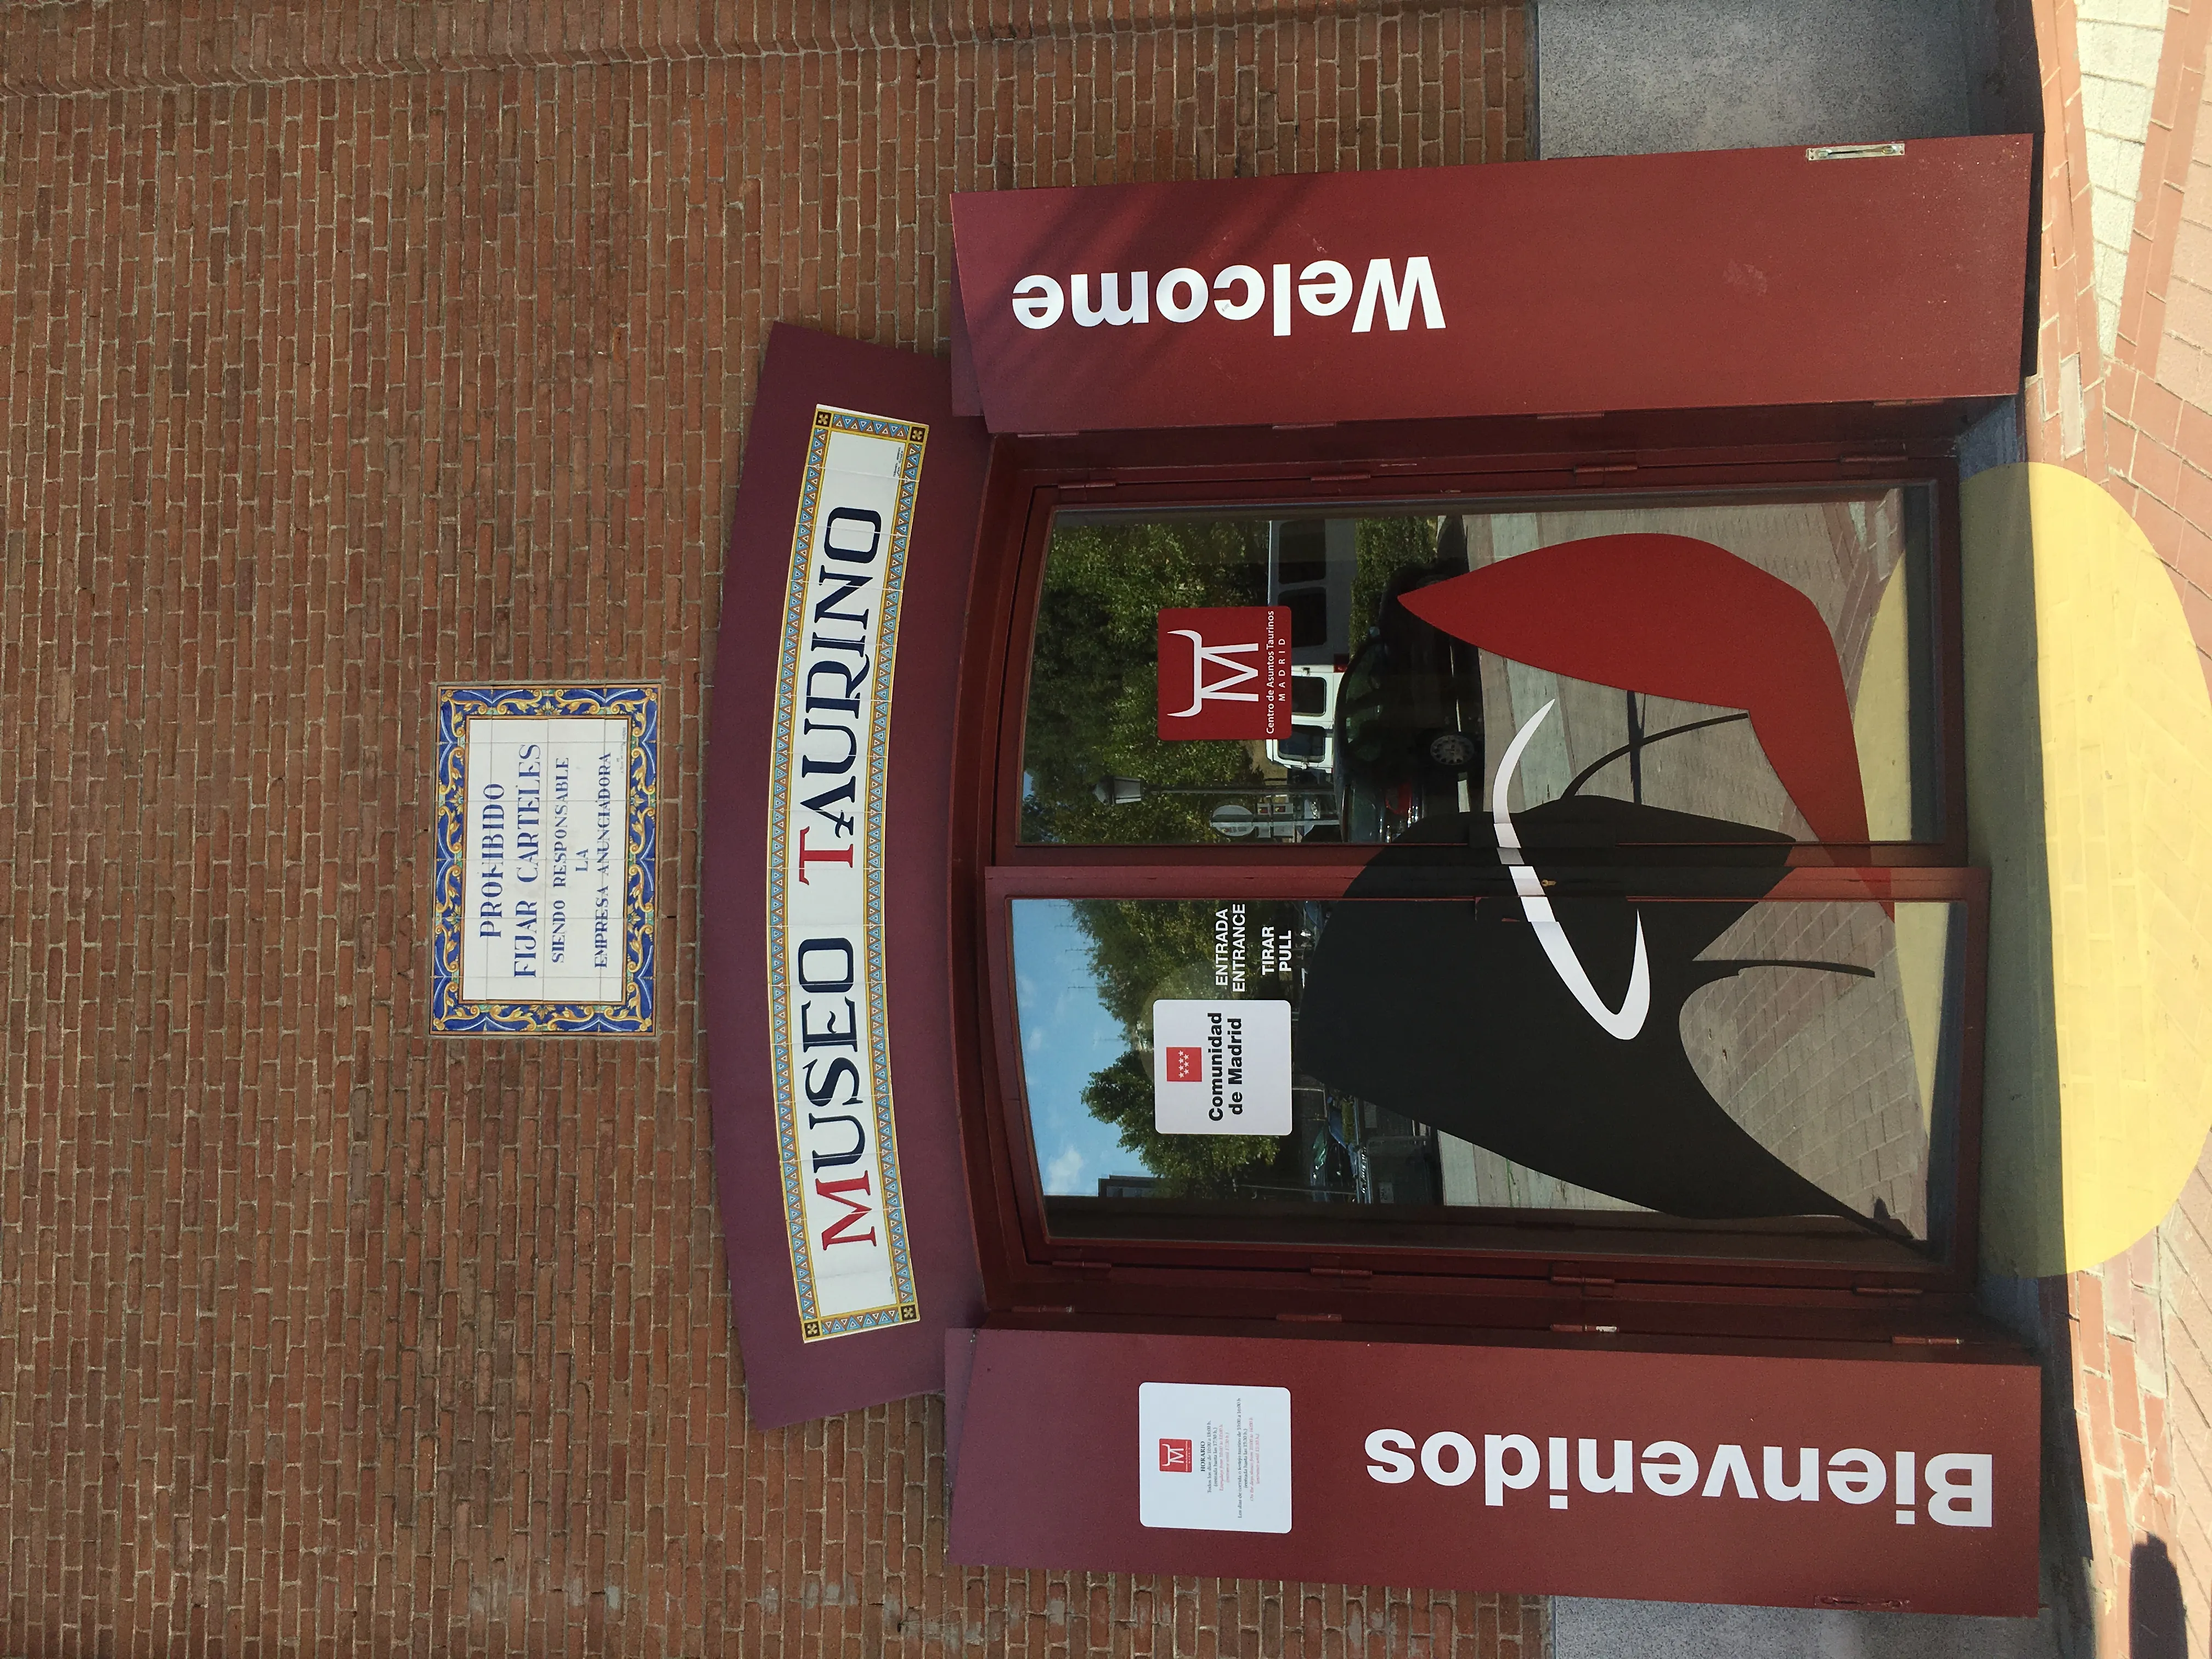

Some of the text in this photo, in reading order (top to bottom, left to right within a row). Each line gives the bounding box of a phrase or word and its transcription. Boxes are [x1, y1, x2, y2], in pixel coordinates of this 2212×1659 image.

[1012, 256, 1446, 336] Welcome
[1266, 611, 1274, 734] Centro de Asuntos Taurinos
[479, 783, 504, 938] PROHIBIDO
[514, 743, 540, 978] FIJAR CARTELES
[552, 757, 569, 963] SIENDO RESPONSABLE
[576, 849, 588, 872] LA
[595, 752, 611, 968] EMPRESA ANUNCIADORA
[798, 507, 882, 1251] MUSEO TAURINO
[1215, 909, 1228, 986] ENTRADA
[1232, 904, 1245, 992] ENTRANCE
[1262, 926, 1274, 975] TIRAR
[1279, 930, 1291, 972] PULL
[1207, 1013, 1223, 1121] Comunidad
[1227, 1018, 1243, 1115] de Madrid
[1364, 1429, 1993, 1527] Bienvenidos
